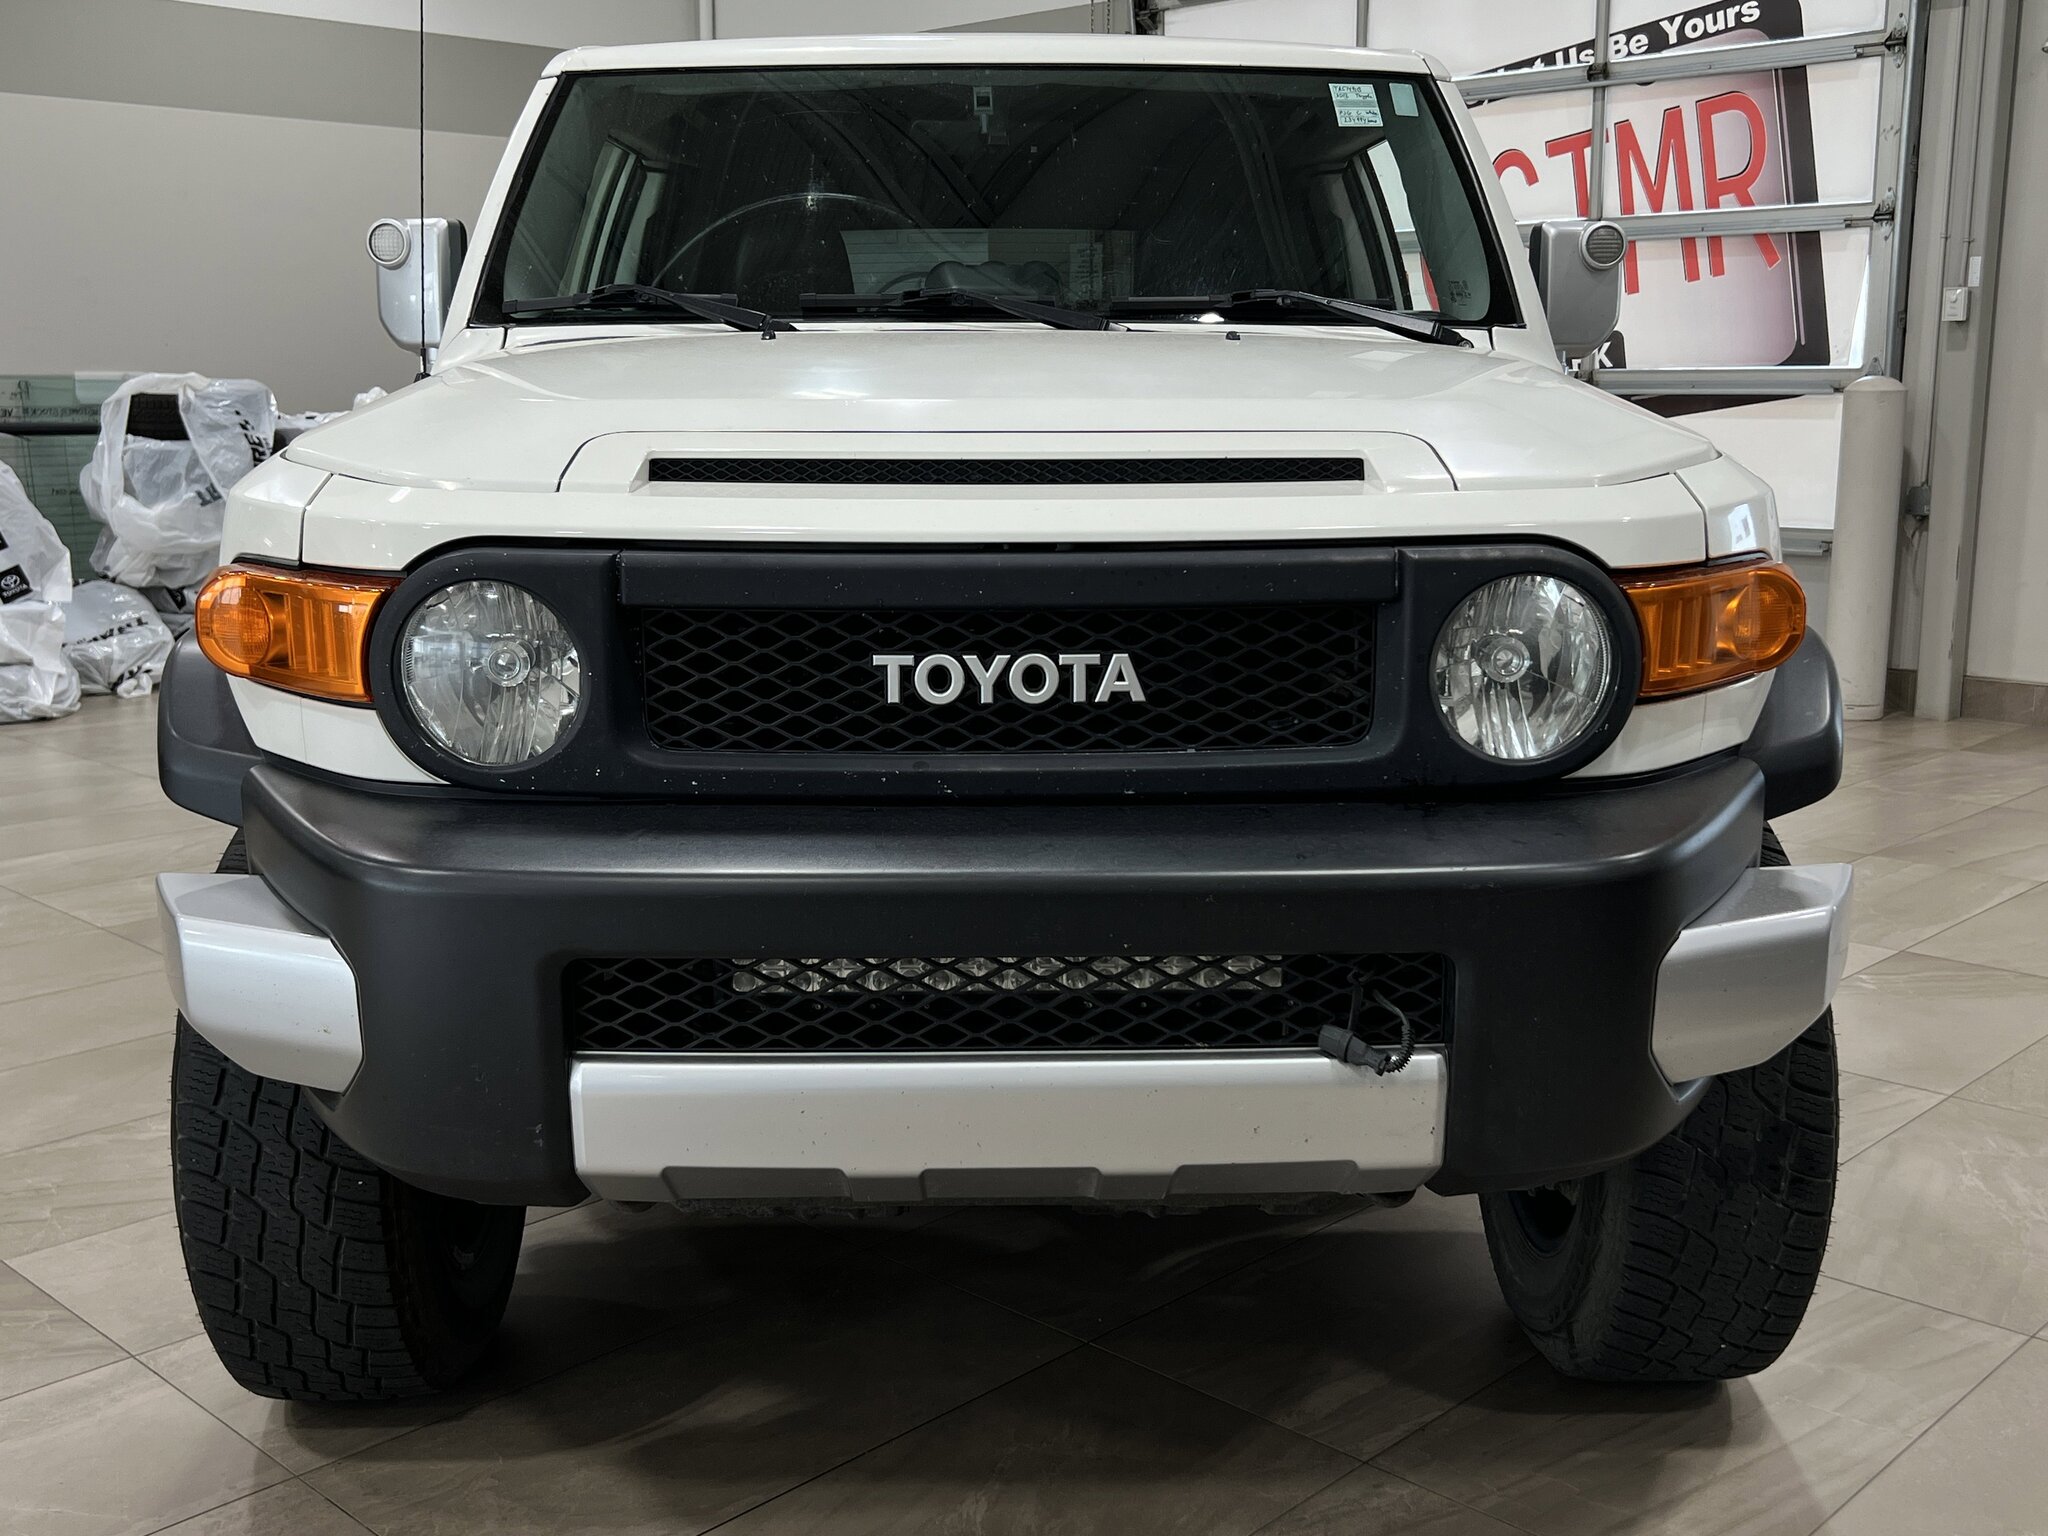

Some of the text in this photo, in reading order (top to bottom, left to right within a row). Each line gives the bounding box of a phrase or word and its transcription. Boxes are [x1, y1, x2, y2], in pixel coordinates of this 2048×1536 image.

[1608, 33, 1649, 60] Be
[1659, 1, 1761, 45] Yours
[872, 653, 1147, 705] TOYOTA
